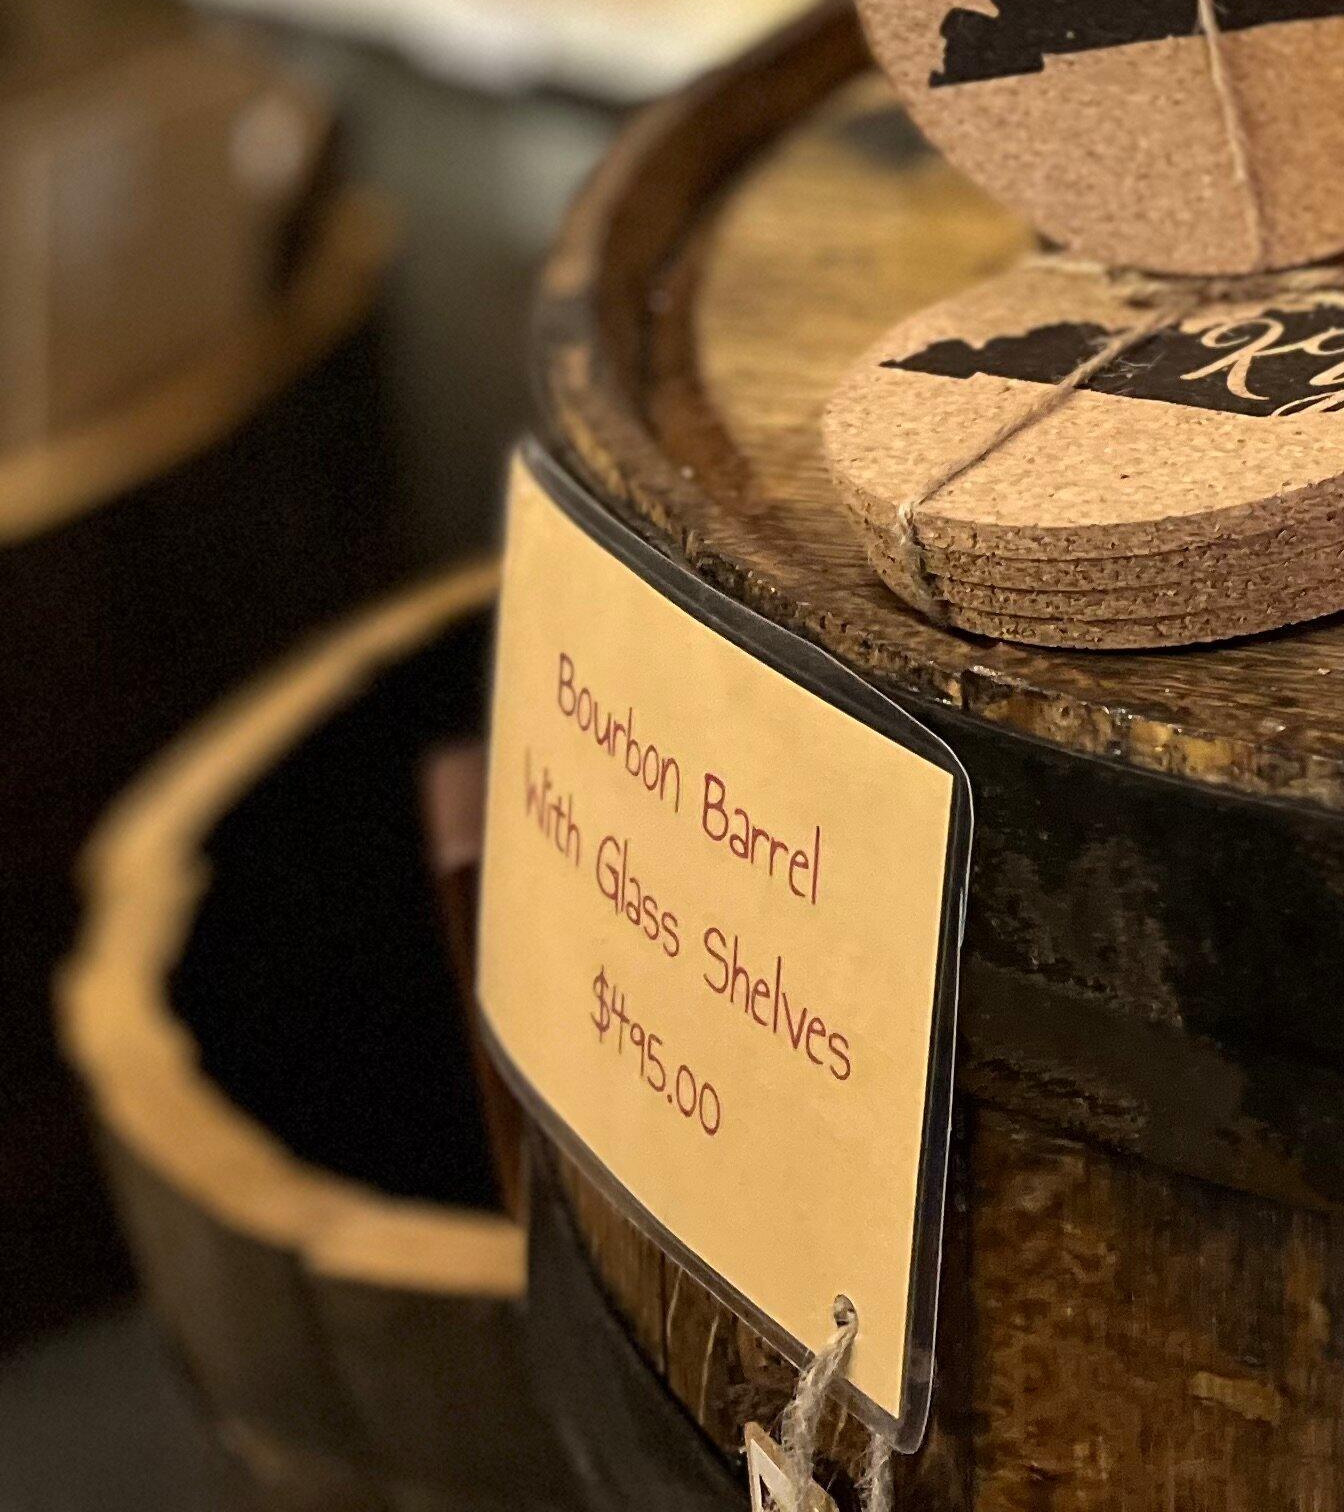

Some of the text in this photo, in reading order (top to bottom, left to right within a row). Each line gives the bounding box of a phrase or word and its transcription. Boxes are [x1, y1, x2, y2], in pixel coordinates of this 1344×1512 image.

[557, 651, 823, 906] Bourbon Barrel
[524, 749, 854, 1083] With Glass Shelves
[589, 965, 723, 1138] $495.00
